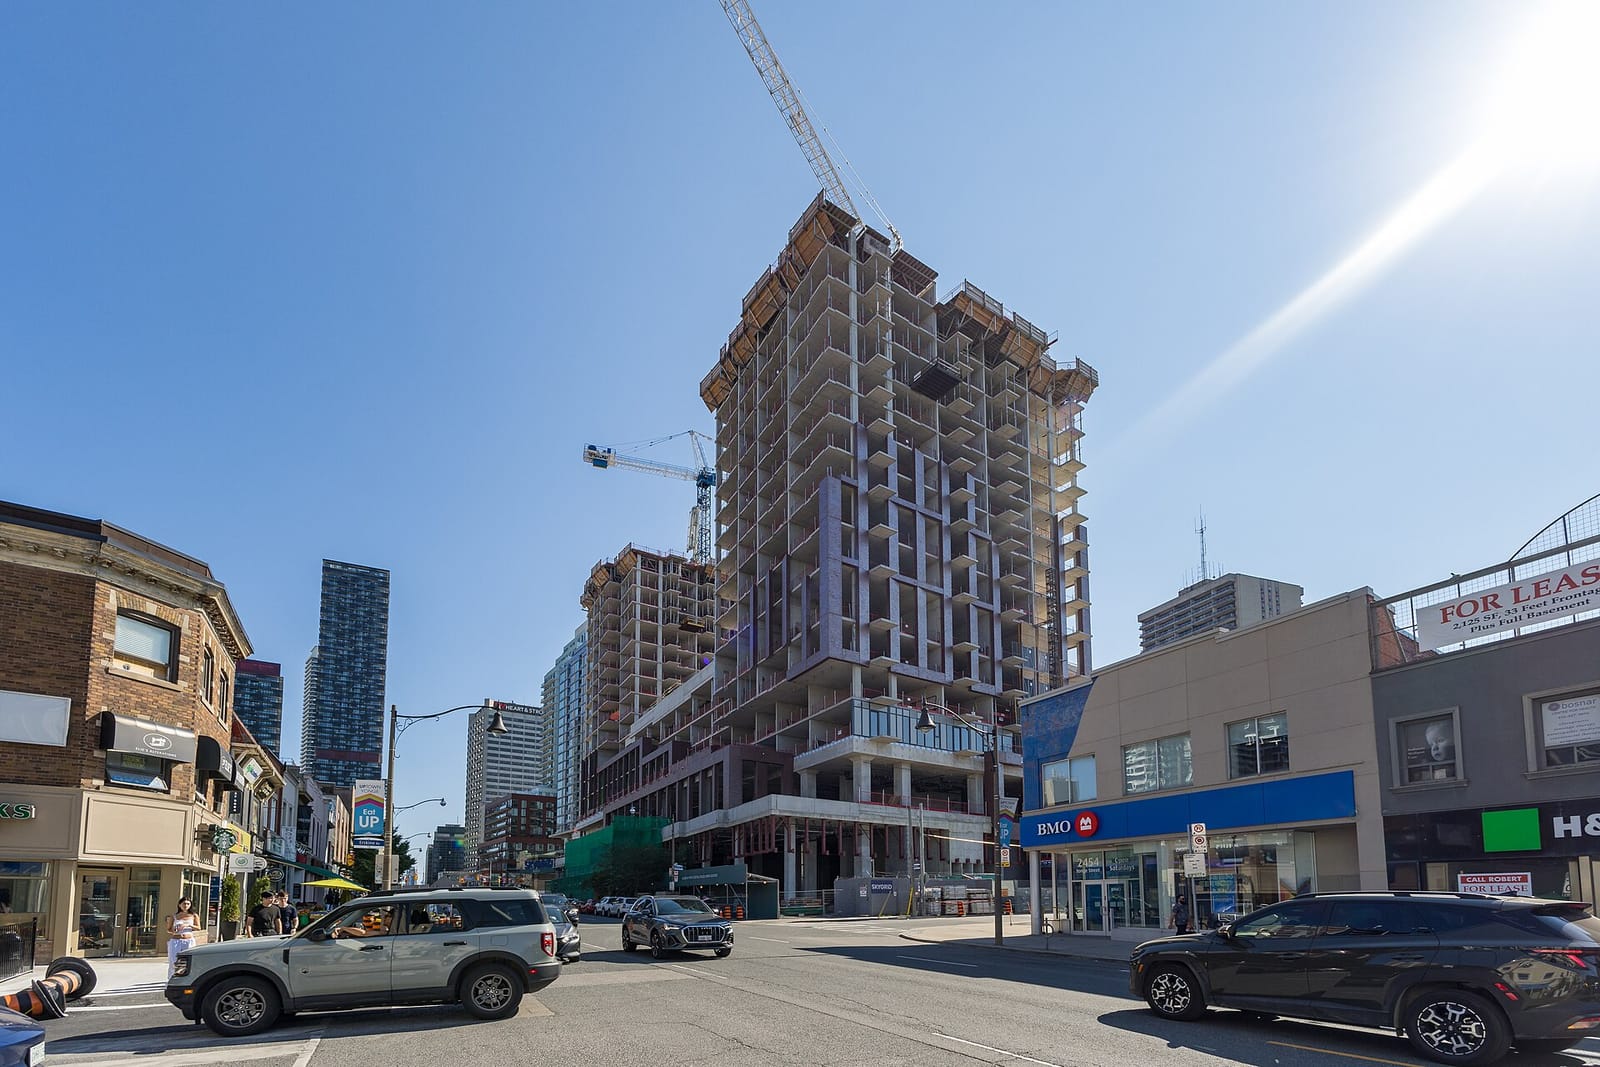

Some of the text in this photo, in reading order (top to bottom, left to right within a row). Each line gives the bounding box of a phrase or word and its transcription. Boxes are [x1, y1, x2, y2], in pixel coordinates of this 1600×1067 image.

[1440, 565, 1600, 624] FOR LEAS
[1453, 617, 1480, 630] 2,125
[1483, 612, 1501, 622] SF,
[1504, 607, 1518, 617] 33
[1522, 601, 1547, 611] Feet
[1470, 598, 1590, 634] Plus Full Basement
[506, 705, 523, 713] HEART
[1561, 699, 1597, 709] bosnar
[359, 816, 379, 828] UP
[1037, 820, 1071, 836] BMO
[1077, 857, 1099, 867] 2454
[1490, 884, 1528, 892] LEASE
